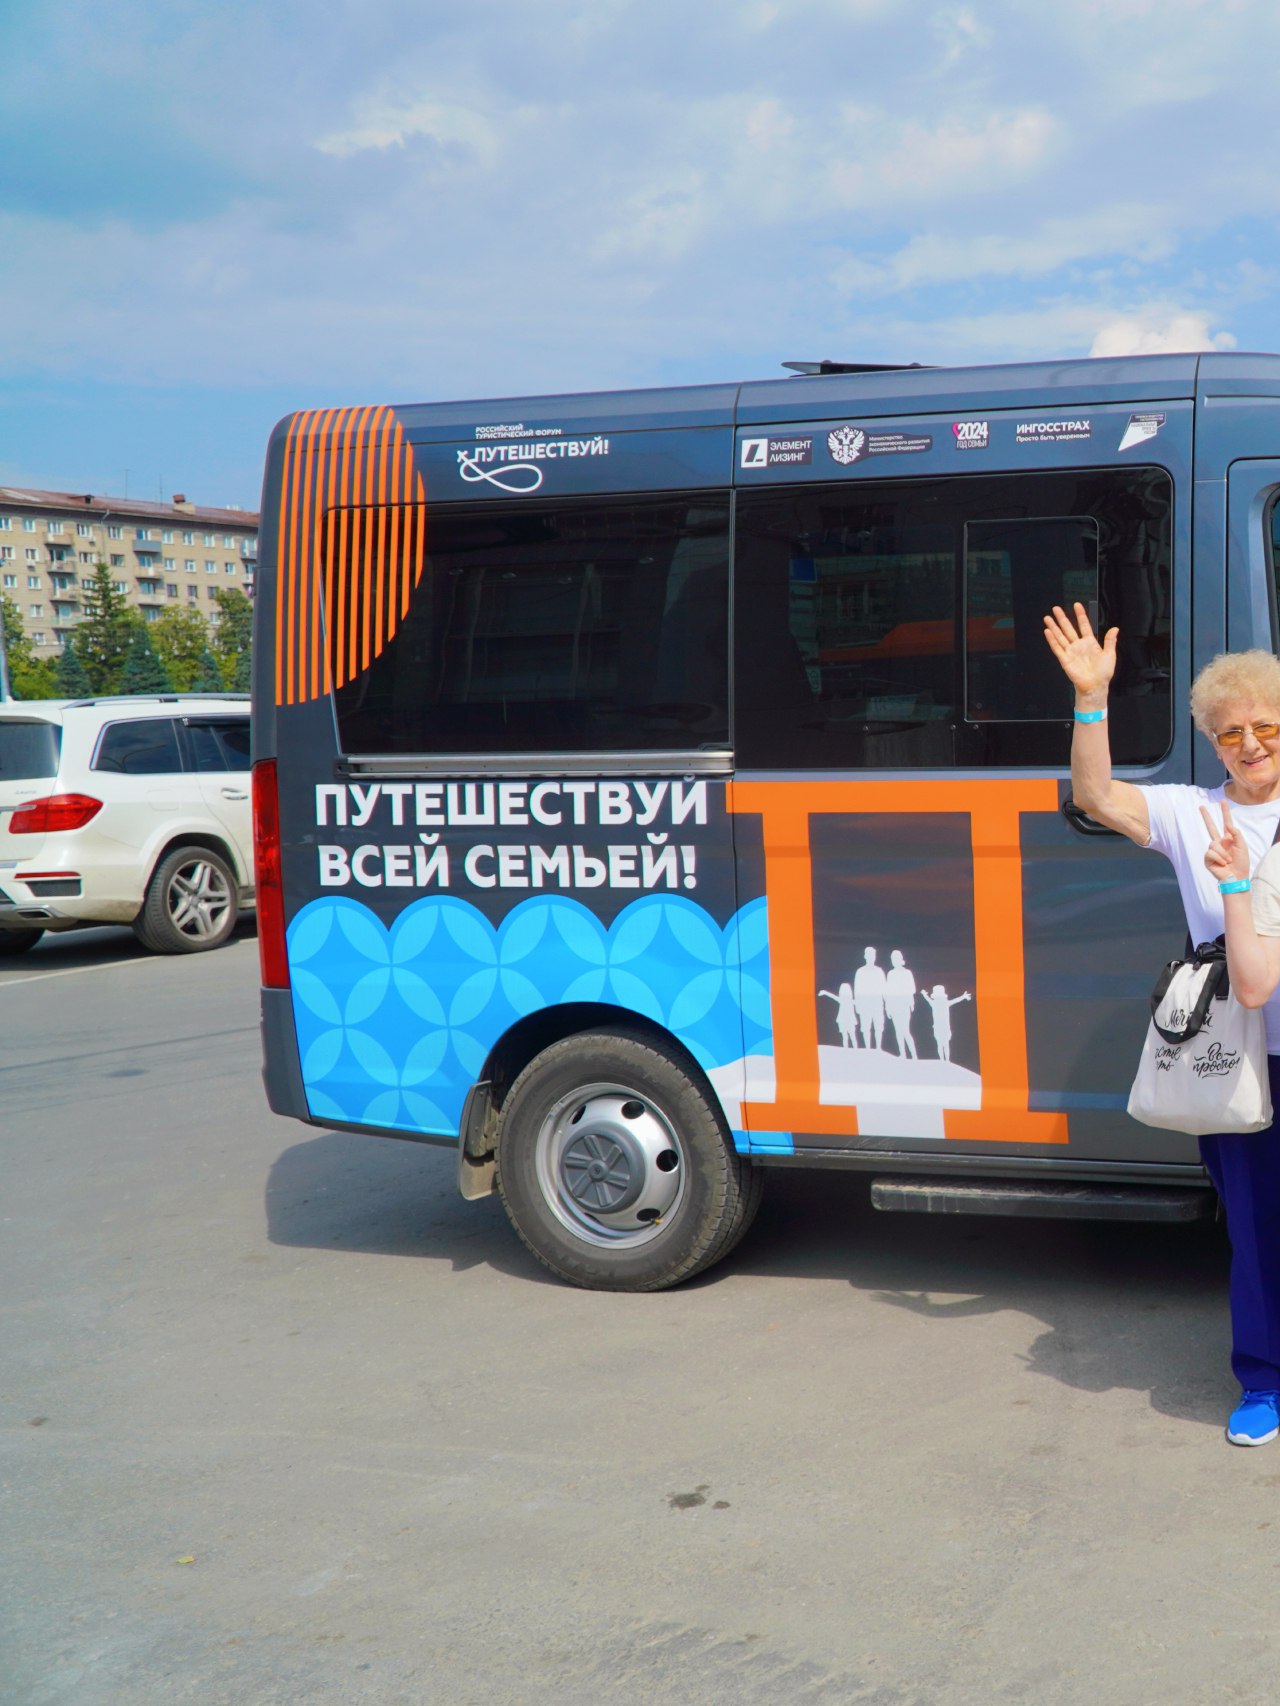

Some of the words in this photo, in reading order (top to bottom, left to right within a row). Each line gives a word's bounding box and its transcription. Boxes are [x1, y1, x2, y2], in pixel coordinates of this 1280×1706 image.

[475, 423, 523, 433] РОССИЙСКИЙ
[956, 421, 989, 440] 2024
[1016, 420, 1090, 434] ИНГОССТРАХ
[475, 429, 534, 440] ТУРИСТИЧЕСКИЙ
[535, 428, 562, 437] ФОРУМ
[1016, 435, 1039, 443] Просто
[1040, 434, 1054, 442] быть
[474, 436, 609, 463] ПУТЕШЕСТВУЙ!
[769, 440, 812, 451] ЭЛЕМЕНТ
[956, 440, 968, 450] ГОД
[968, 439, 988, 448] СЕМЬИ
[769, 452, 805, 463] ЛИЗИНГ
[315, 774, 708, 826] ПУТЕШЕСТВУЙ
[318, 832, 451, 888] ВСЕЙ
[464, 832, 698, 890] СЕМЬЕЙ!
